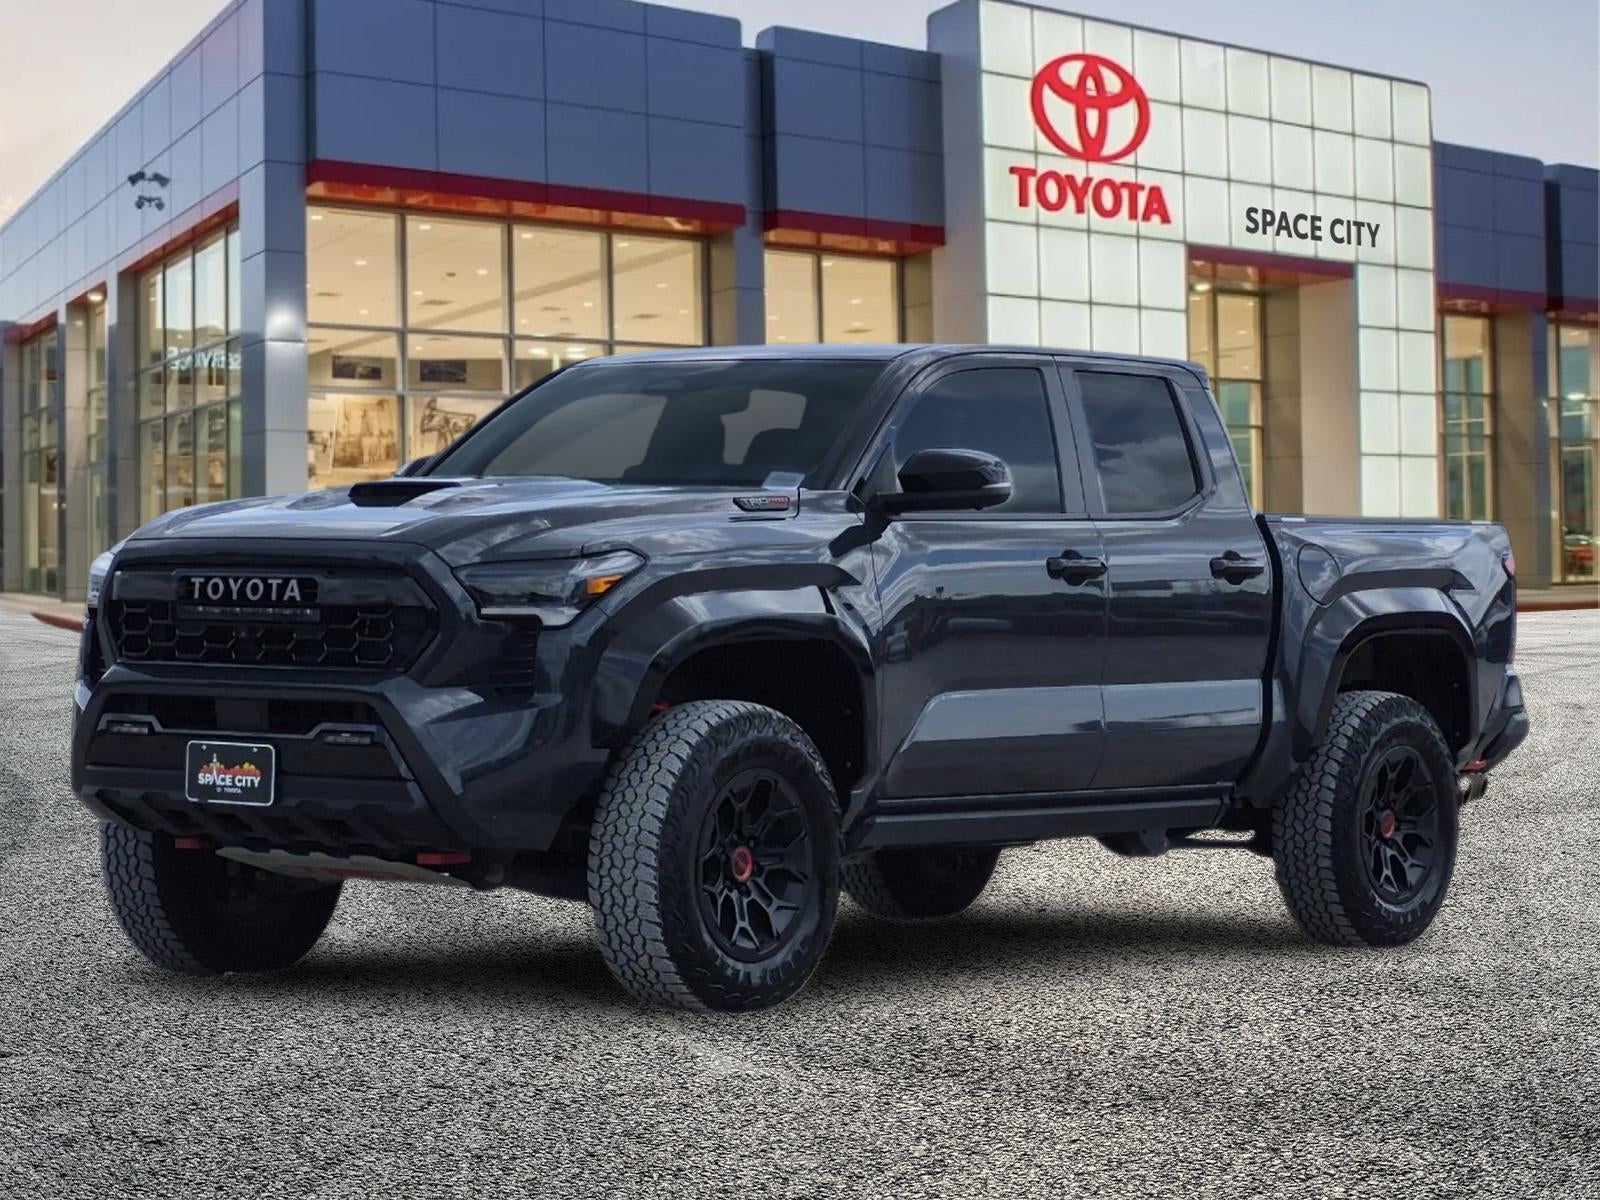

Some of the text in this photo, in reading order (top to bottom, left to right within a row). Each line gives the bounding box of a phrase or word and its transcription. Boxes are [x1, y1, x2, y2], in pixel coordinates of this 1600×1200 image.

[1009, 166, 1171, 224] TOYOTA
[1245, 206, 1380, 248] SPACE CITY
[190, 577, 301, 601] TOYOTA
[197, 771, 261, 788] SPACE CITY
